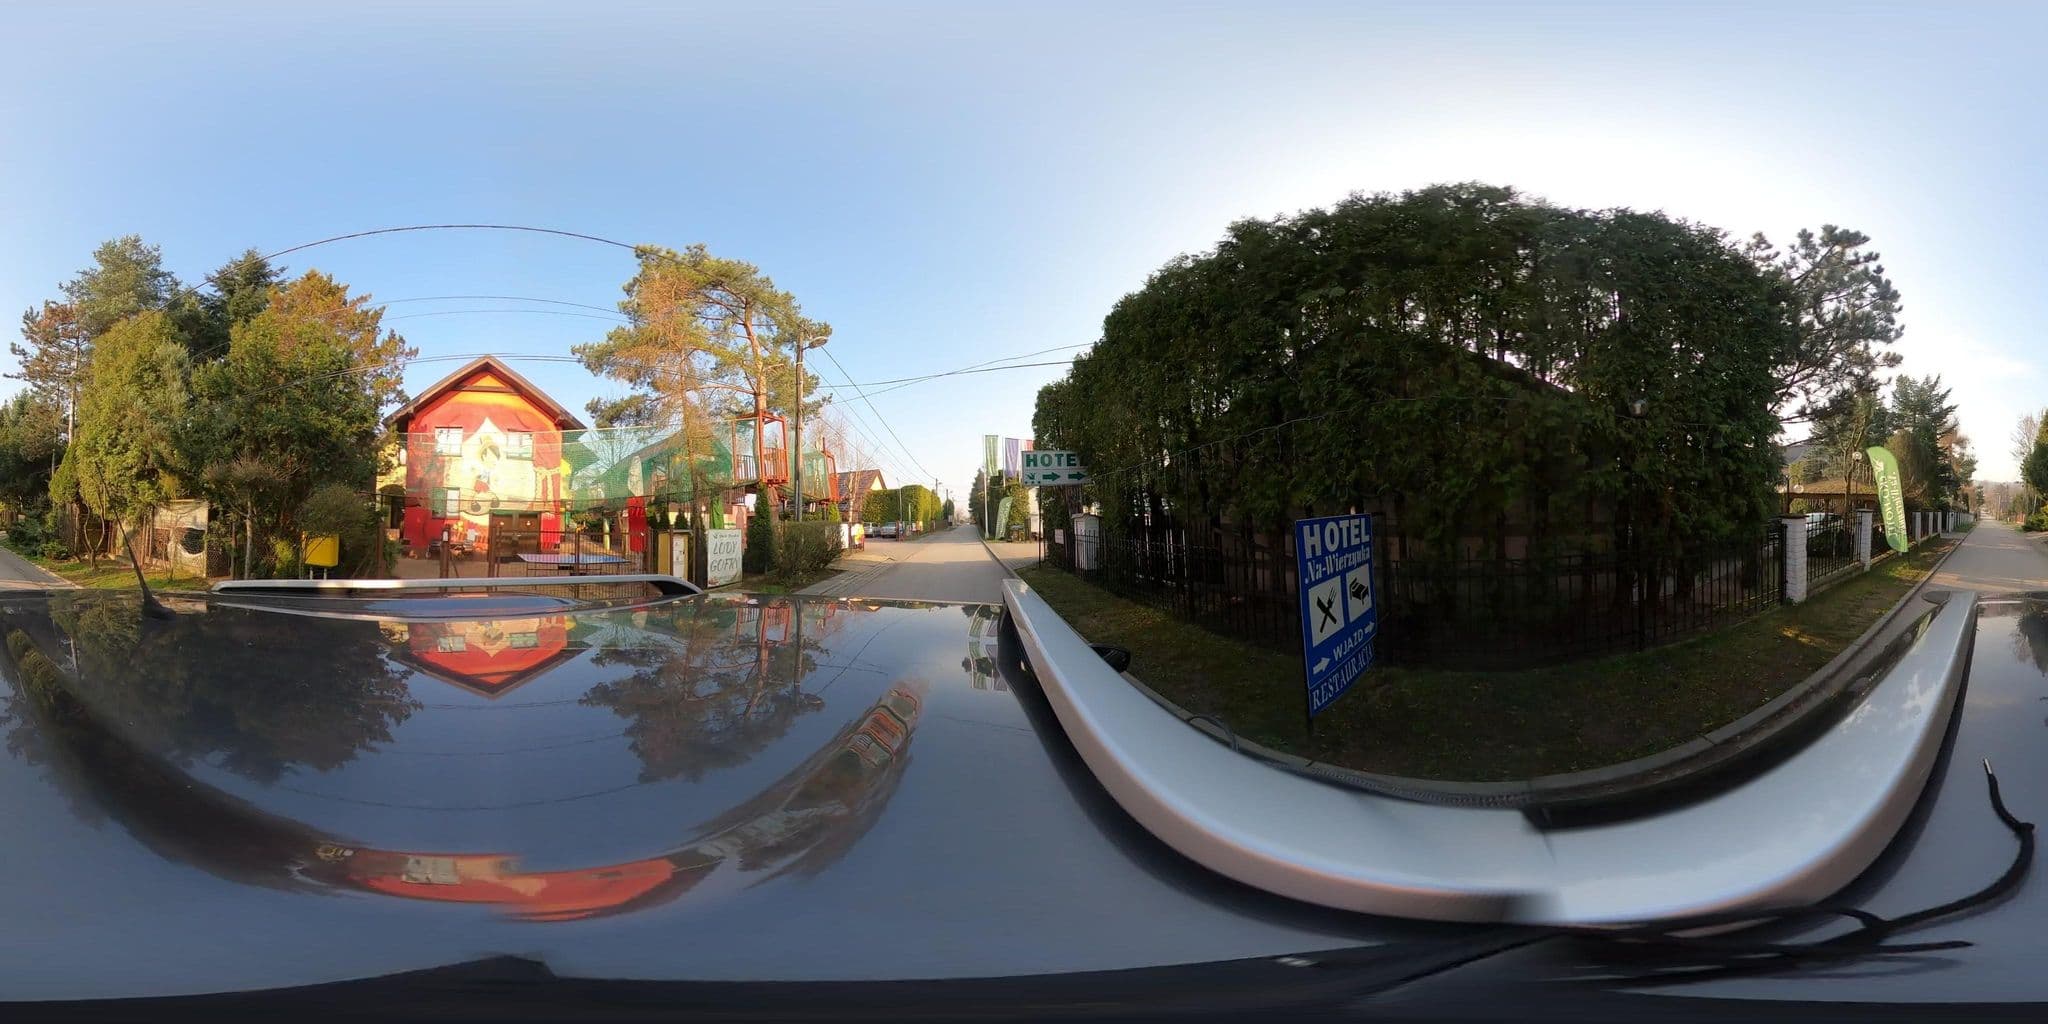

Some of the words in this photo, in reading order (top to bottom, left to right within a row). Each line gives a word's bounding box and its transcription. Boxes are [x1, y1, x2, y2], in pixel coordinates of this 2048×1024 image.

[1303, 517, 1370, 559] HOTEL
[1305, 545, 1370, 584] Na-Wierzynka
[1333, 629, 1364, 661] WJAZD
